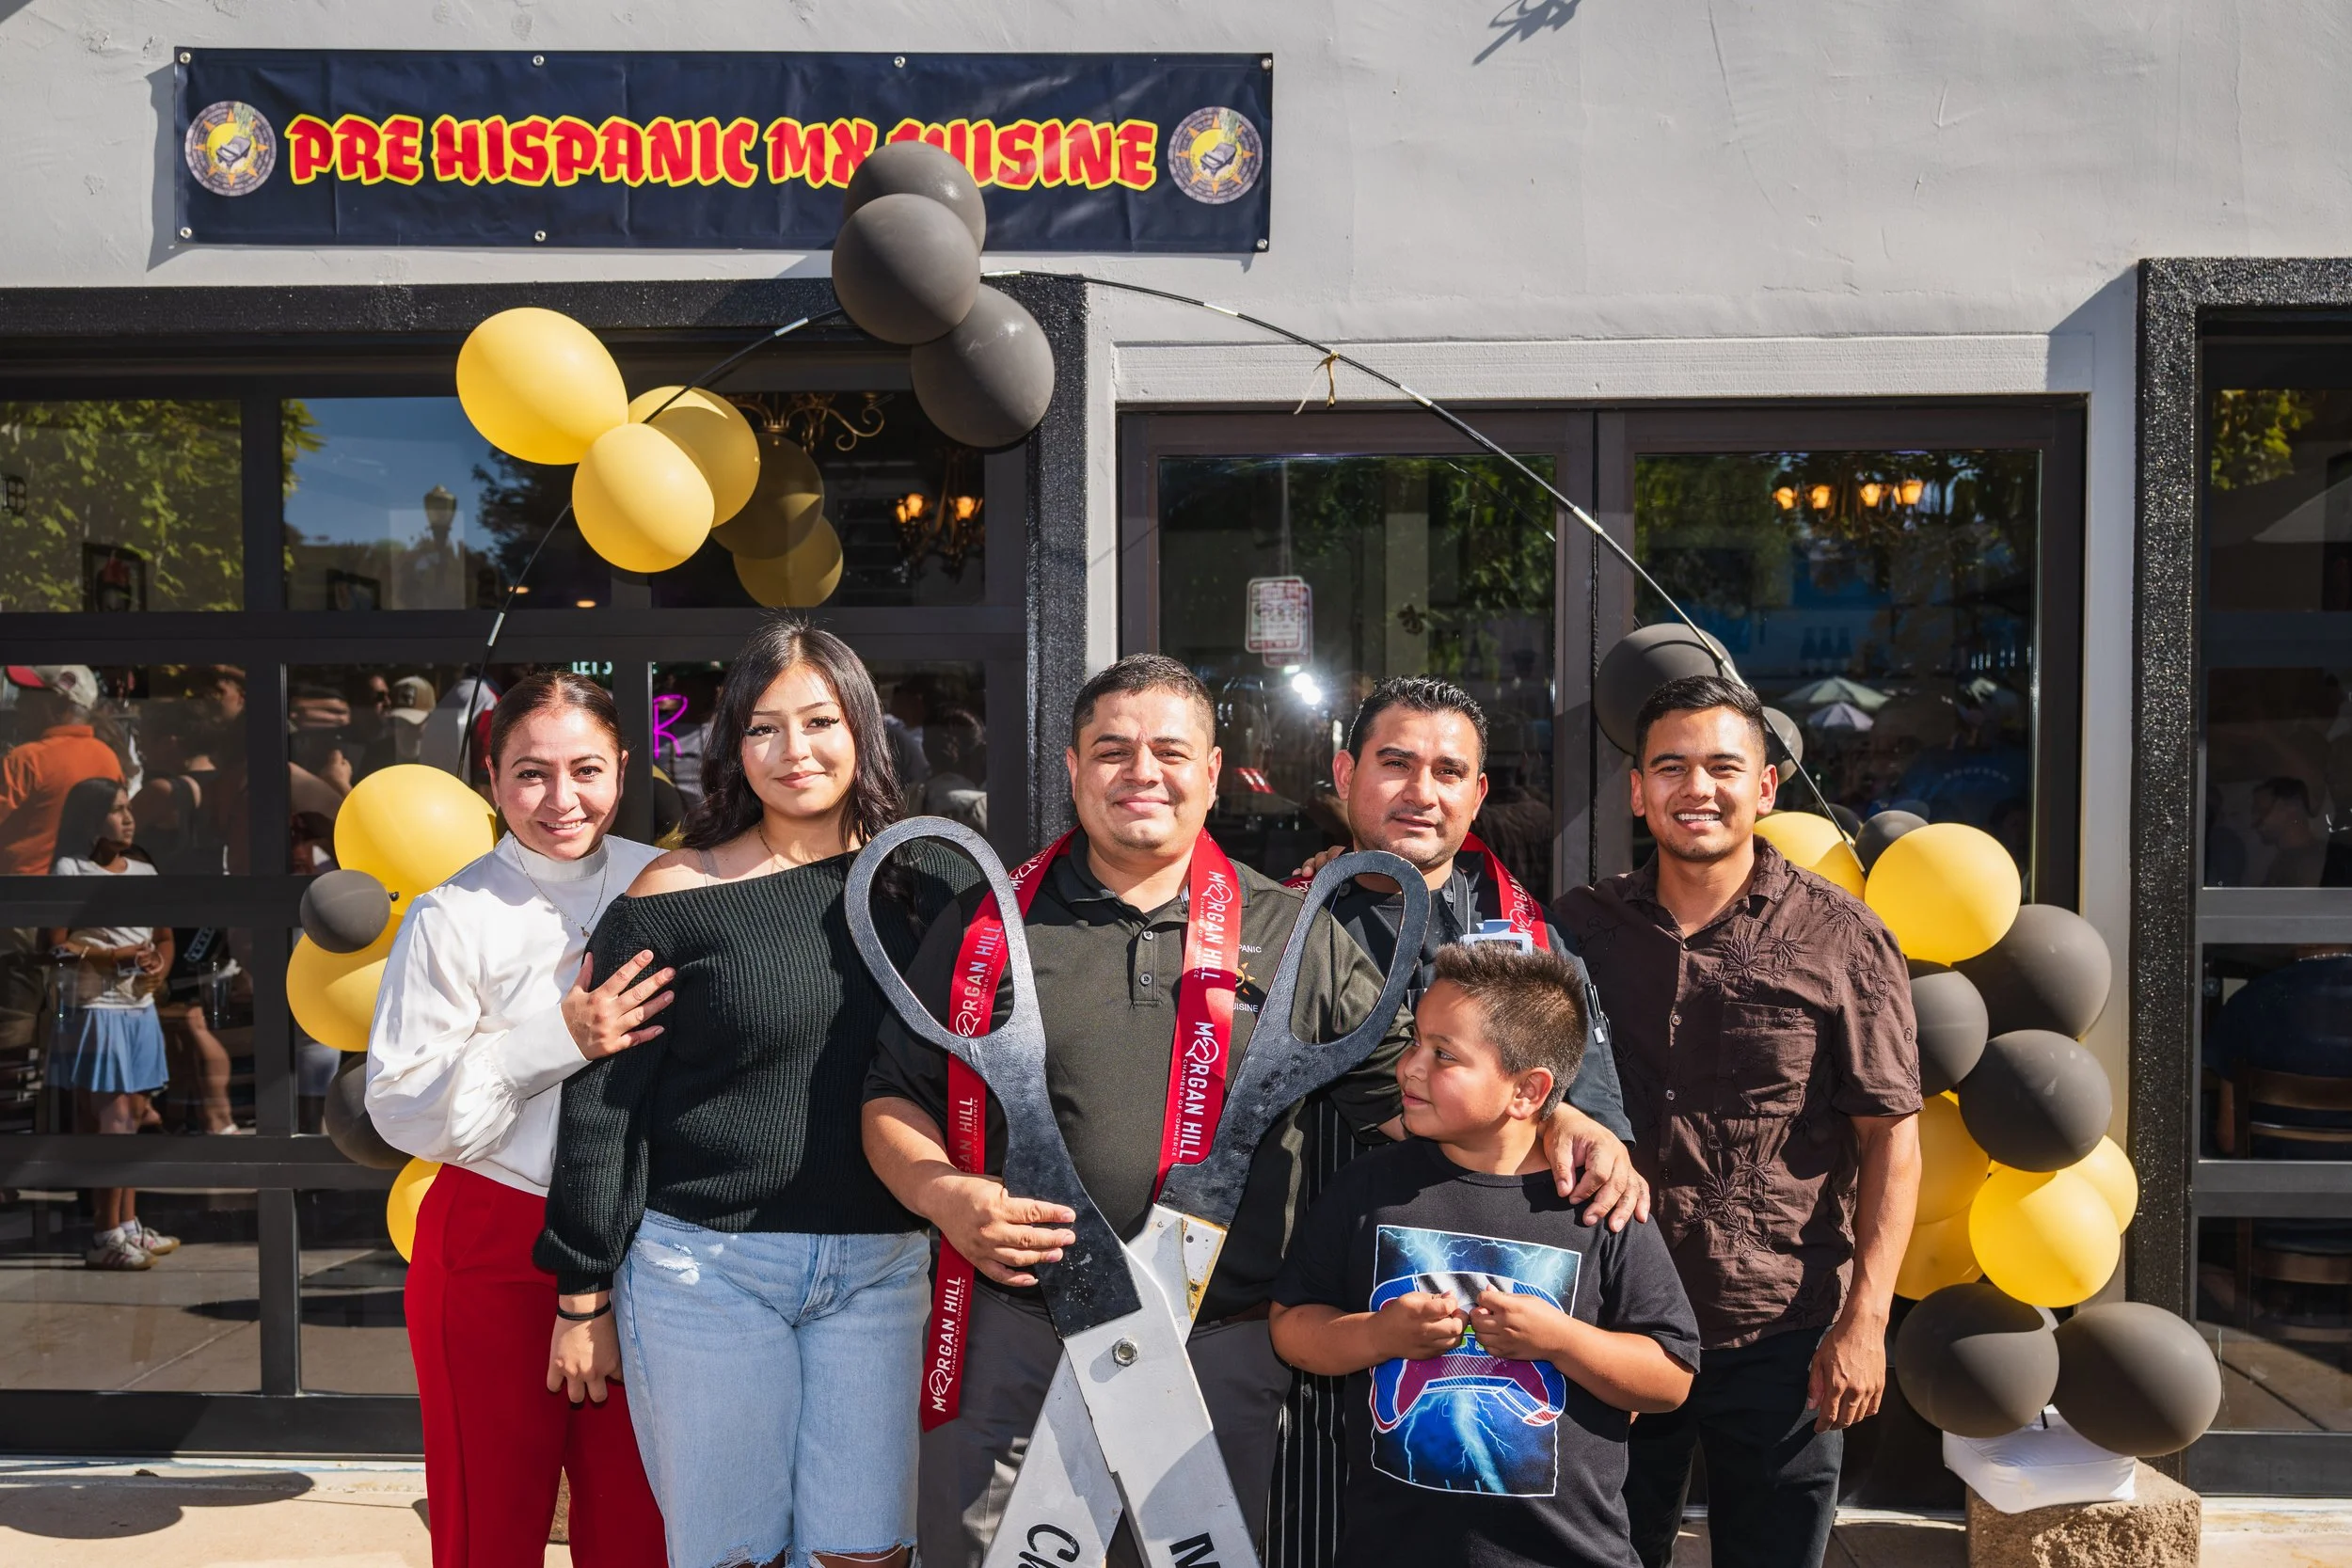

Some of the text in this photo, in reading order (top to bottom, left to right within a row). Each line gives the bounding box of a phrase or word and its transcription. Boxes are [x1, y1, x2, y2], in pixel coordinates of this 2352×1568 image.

[284, 114, 1158, 191] PRE HISPANIC MX UISINE
[1201, 870, 1232, 944] MORGAN
[1238, 944, 1262, 953] PANIC
[956, 926, 1004, 1037] ORGAN HILL
[1200, 947, 1223, 980] HILL
[959, 1097, 973, 1133] HILL
[1171, 1059, 1188, 1156] CHAMBER OF COMMERCE
[1179, 1022, 1219, 1159] MORGAN HILL
[929, 1276, 961, 1412] MORGAN HILL
[950, 1279, 966, 1375] CHAMBER OF COMMERCE
